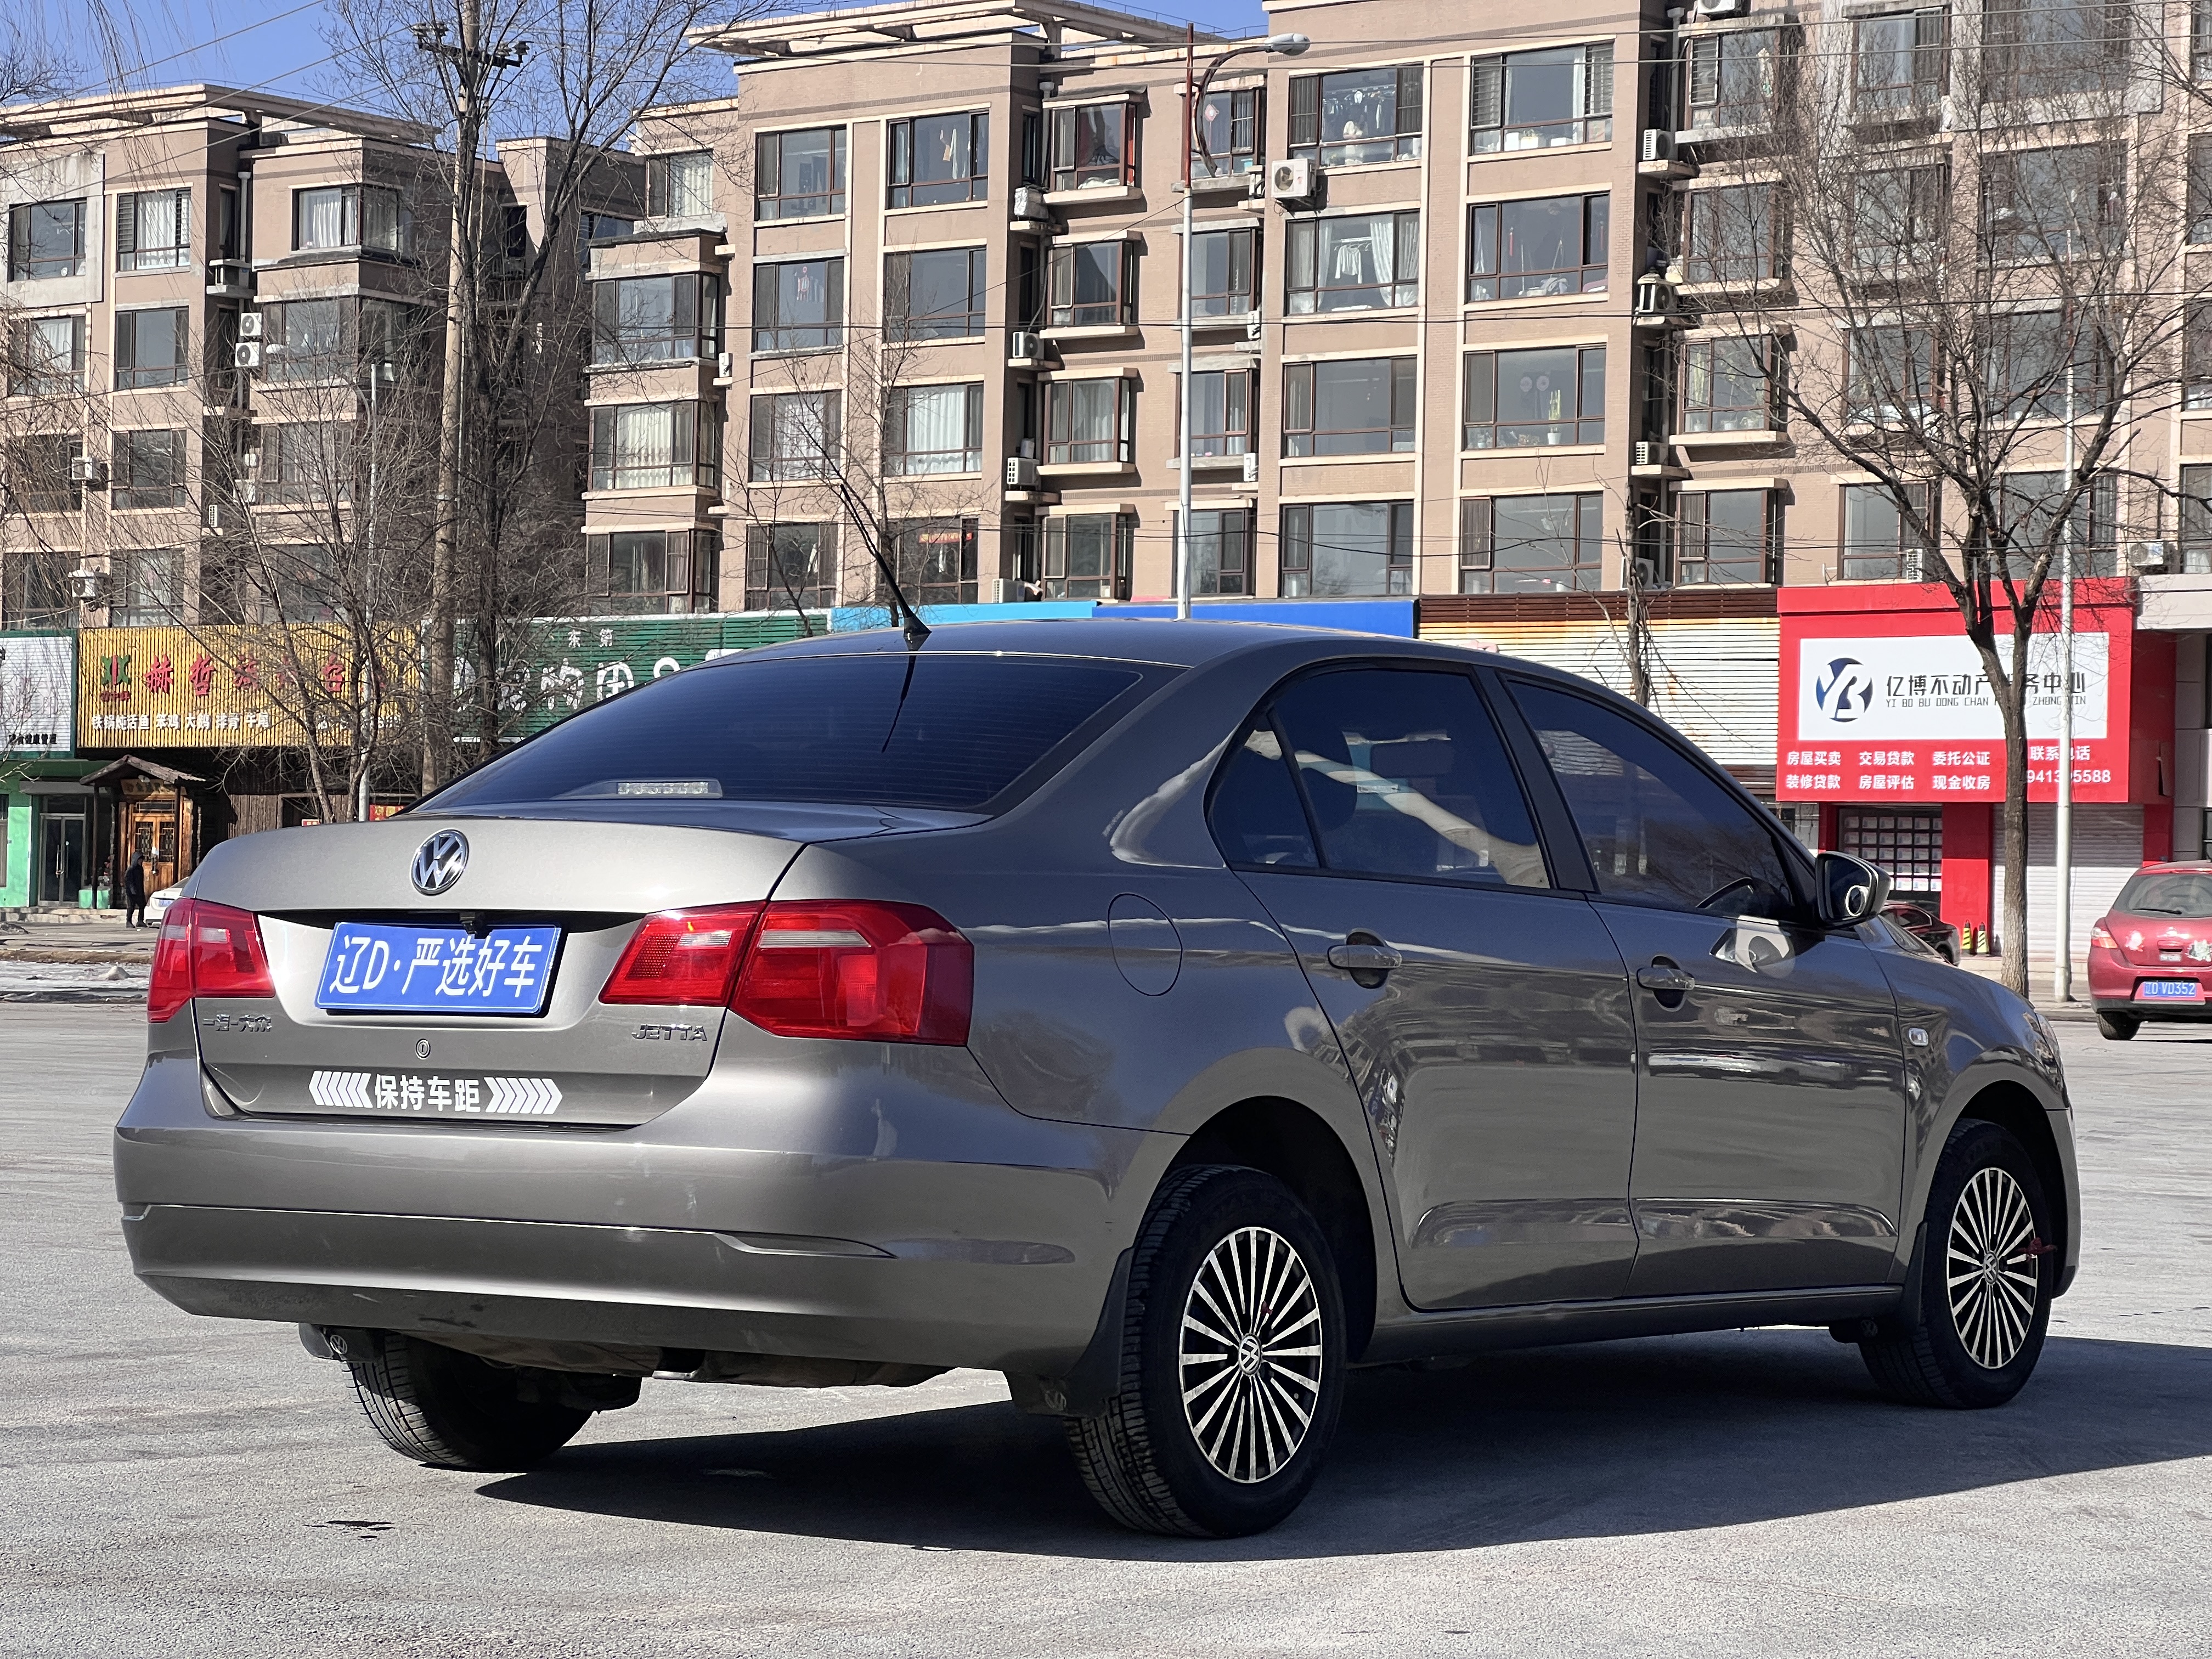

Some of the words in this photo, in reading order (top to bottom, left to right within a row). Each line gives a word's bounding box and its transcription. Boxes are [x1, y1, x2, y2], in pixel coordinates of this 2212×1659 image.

[1886, 672, 2086, 697] 亿博不动产务中心
[1886, 698, 1897, 708] YI
[1902, 698, 1914, 708] BO
[1918, 698, 1931, 707] BU
[1936, 697, 1959, 707] DONG
[1964, 697, 1989, 706] CHAN
[92, 714, 150, 731] 铁锅炖活鱼
[156, 713, 180, 731] 笨鸡
[185, 713, 211, 731] 大鹅
[1787, 751, 1842, 766] 房屋买卖
[1859, 751, 1915, 766] 交易贷款
[1933, 751, 1991, 766] 委托公证
[2030, 746, 2091, 761] 联系话
[1786, 774, 1841, 789] 装修贷款
[1859, 775, 1915, 790] 房屋评估
[1933, 775, 1991, 791] 现金收房
[329, 934, 543, 998] 辽D·严选好车
[631, 1023, 708, 1041] JETTA
[374, 1074, 481, 1113] 保持车距
